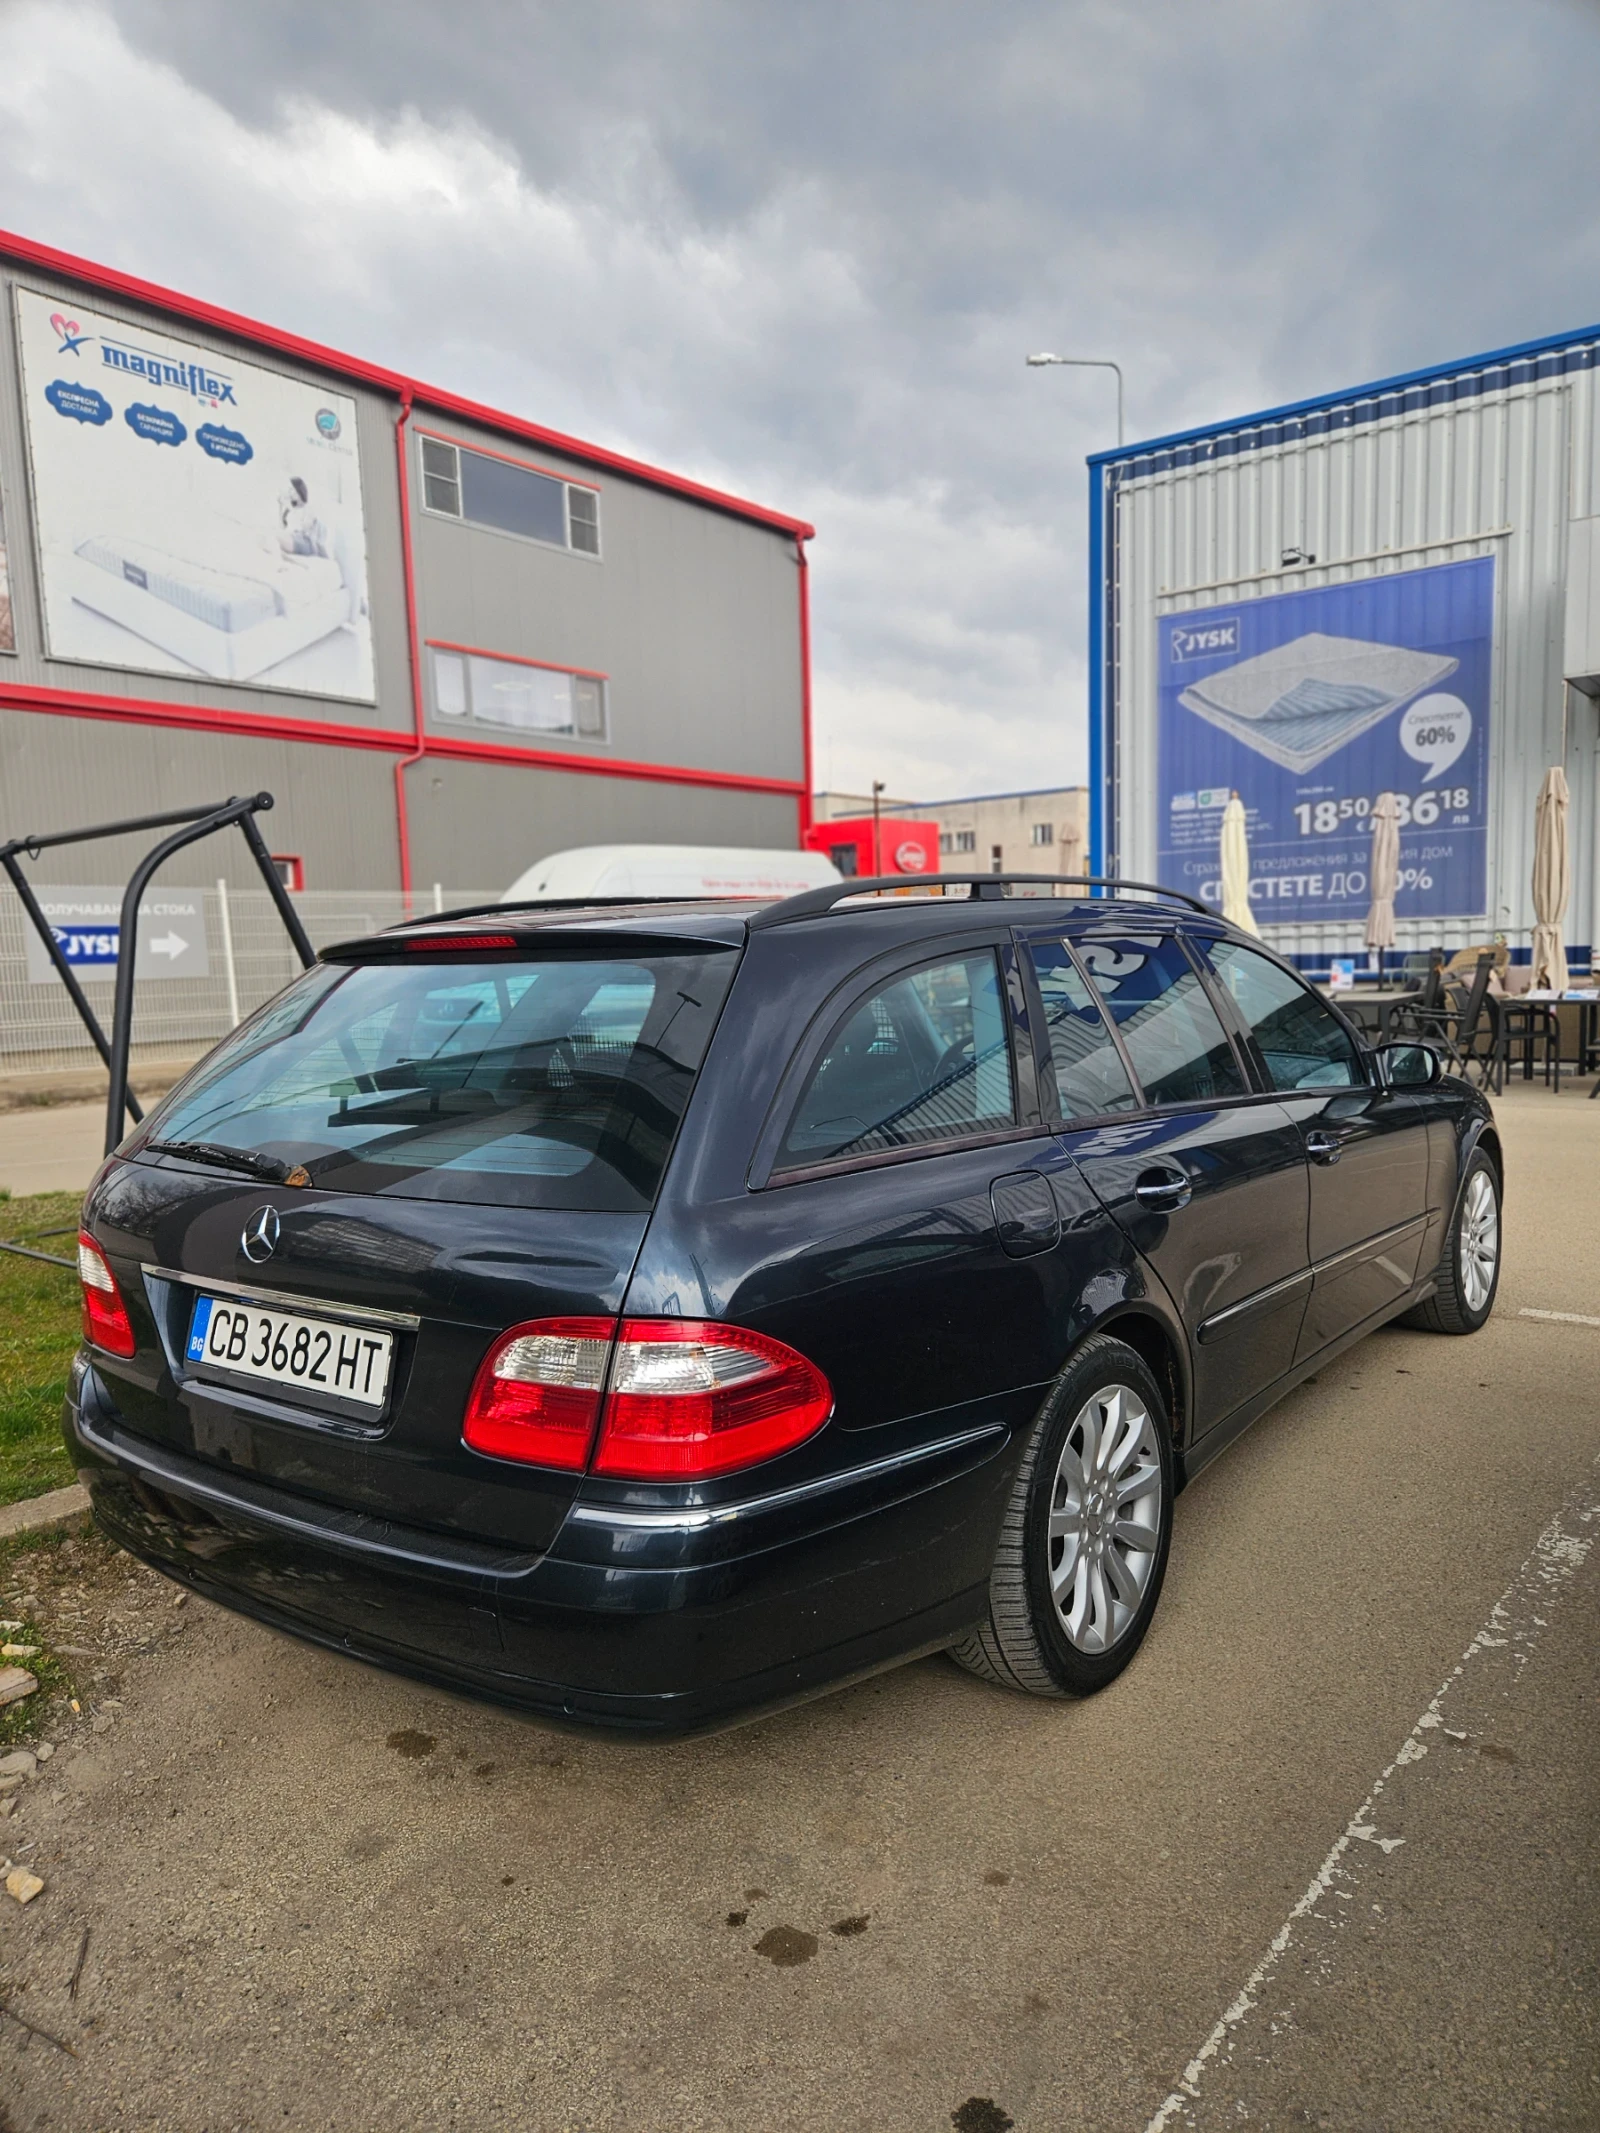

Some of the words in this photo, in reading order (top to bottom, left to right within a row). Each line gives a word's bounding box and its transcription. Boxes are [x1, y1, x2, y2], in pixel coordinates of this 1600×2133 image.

[101, 345, 237, 406] magniflex
[1185, 627, 1235, 651] JYSK
[1415, 725, 1456, 747] 60%
[1253, 851, 1348, 872] предложения
[1352, 851, 1368, 864] за
[1421, 846, 1453, 861] дом
[1327, 871, 1367, 900] ДО
[1394, 867, 1433, 892] 0%
[153, 903, 196, 916] СТОКА
[190, 1336, 204, 1352] BG
